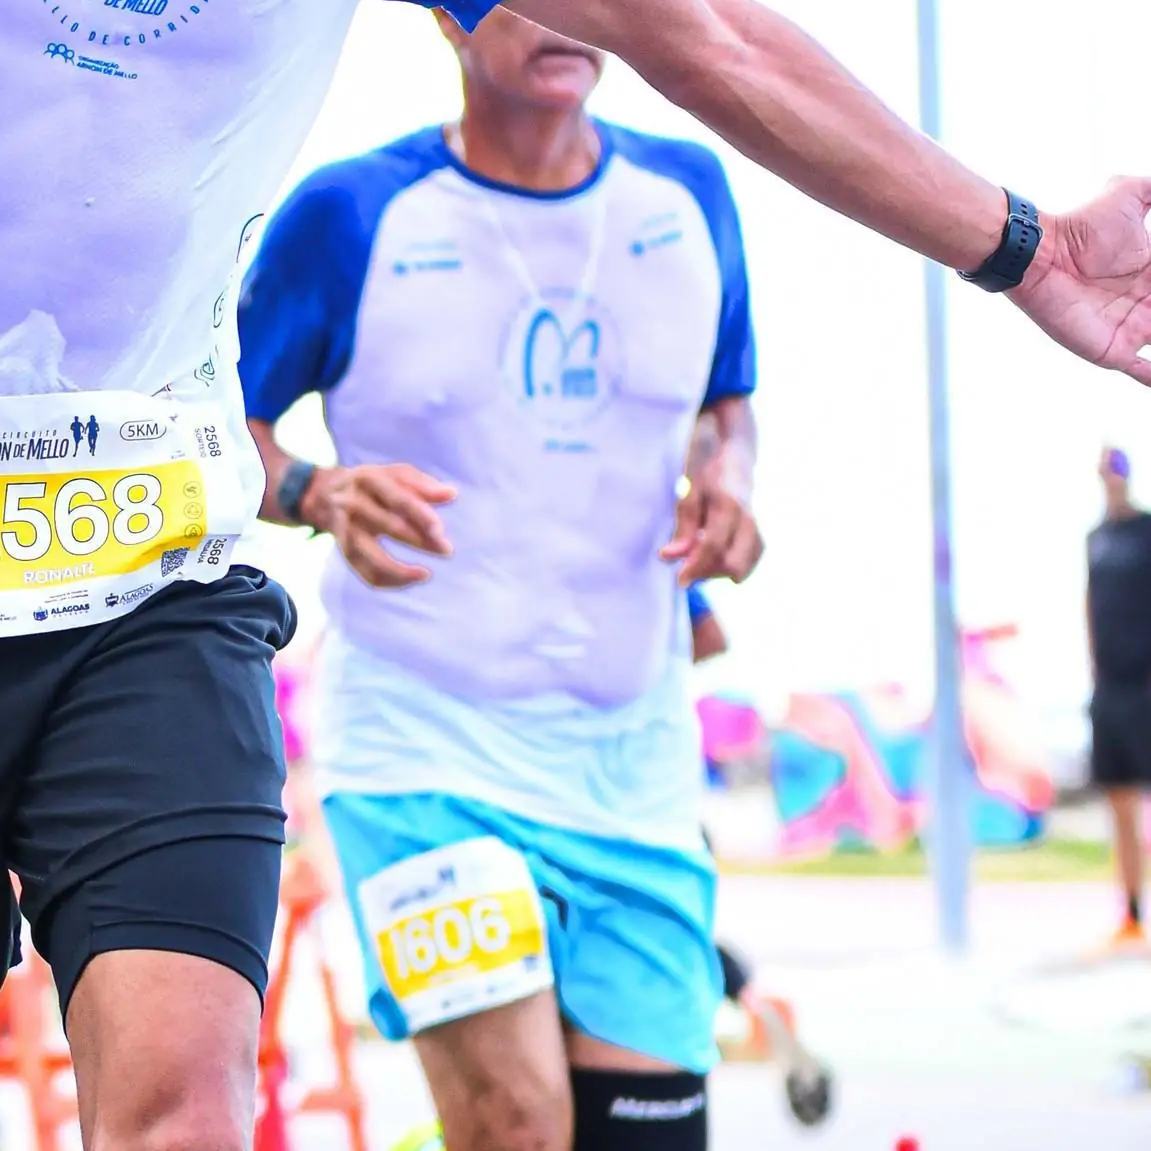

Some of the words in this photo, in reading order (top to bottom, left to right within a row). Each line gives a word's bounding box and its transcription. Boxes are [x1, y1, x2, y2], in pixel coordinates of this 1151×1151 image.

[88, 31, 109, 45] DE
[2, 429, 57, 439] CIRCUITO
[128, 423, 159, 438] 5KM
[13, 444, 27, 458] DE
[27, 438, 70, 460] MELLO
[204, 425, 222, 457] 2568
[207, 538, 227, 565] 2568
[51, 603, 90, 615] ALAGOAS
[389, 897, 511, 980] 1606
